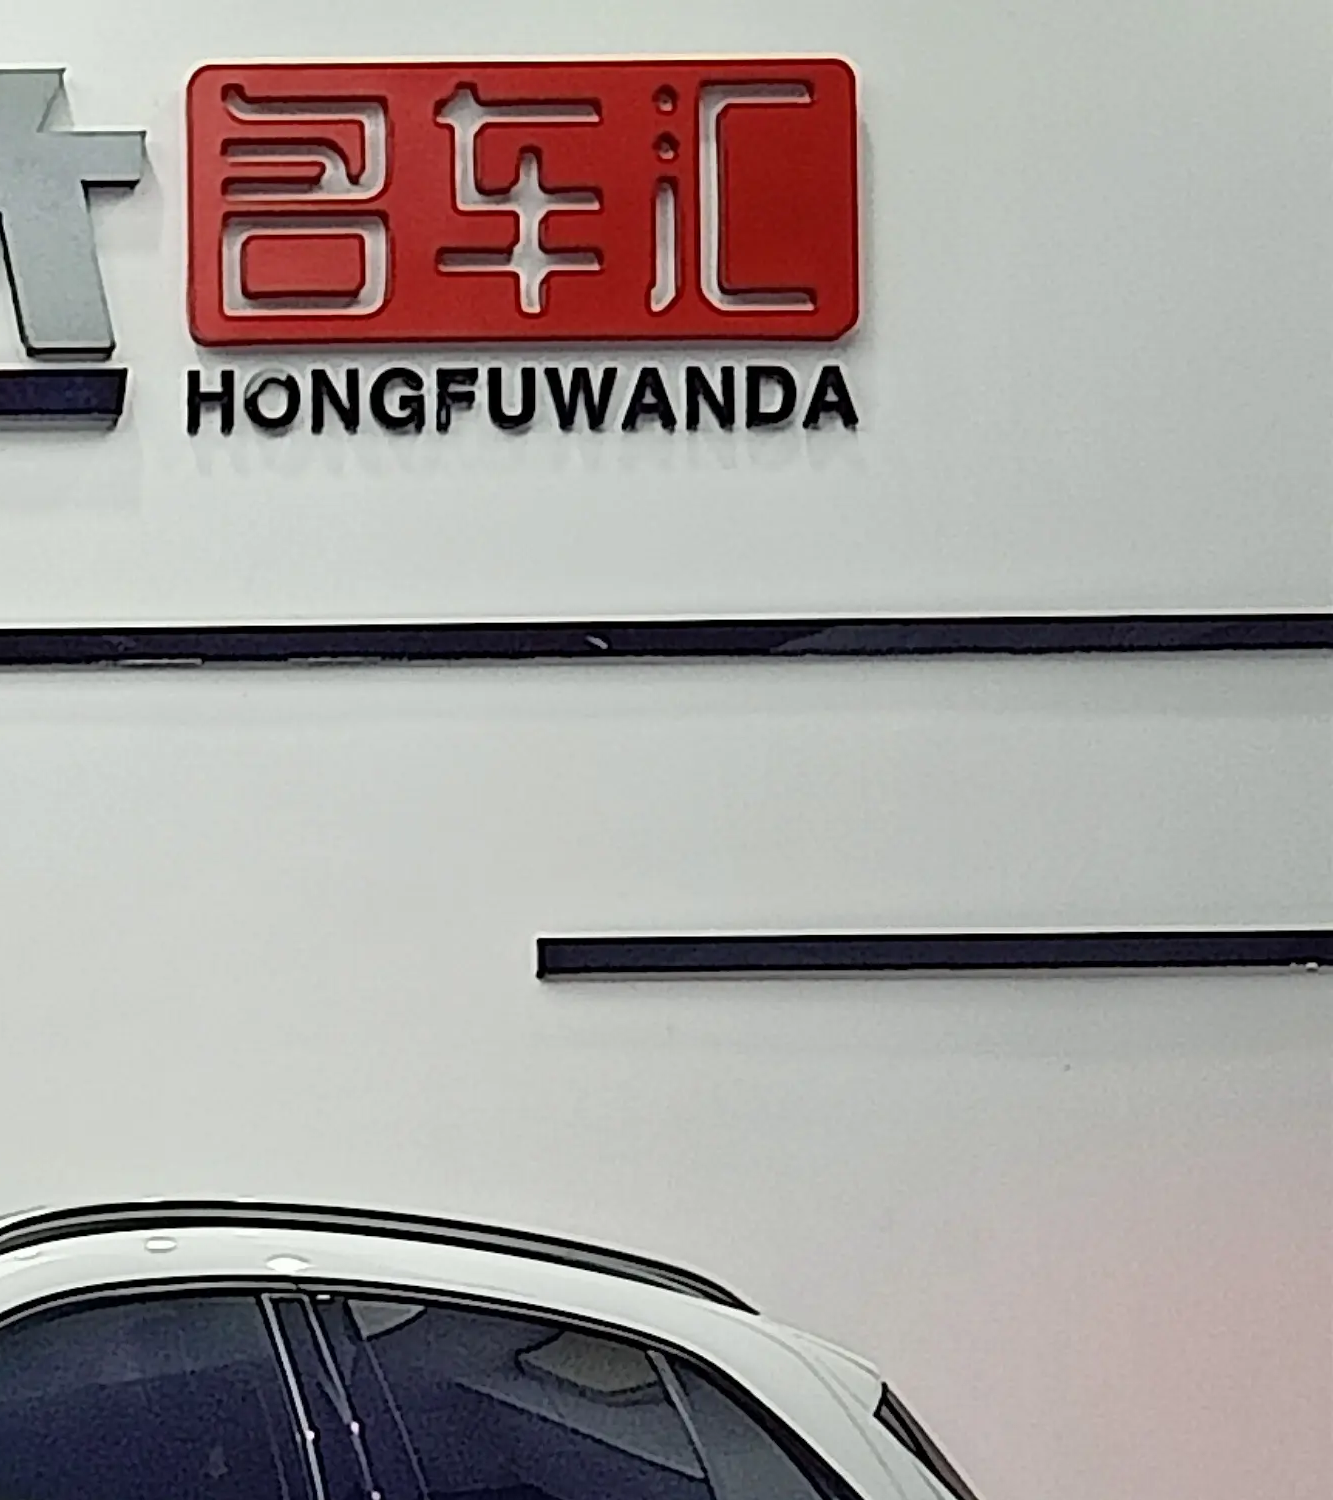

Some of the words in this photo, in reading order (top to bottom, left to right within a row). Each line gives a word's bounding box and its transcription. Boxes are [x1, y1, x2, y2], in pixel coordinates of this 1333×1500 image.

[218, 80, 818, 318] 名车汇
[186, 364, 859, 433] HONGFUWANDA
